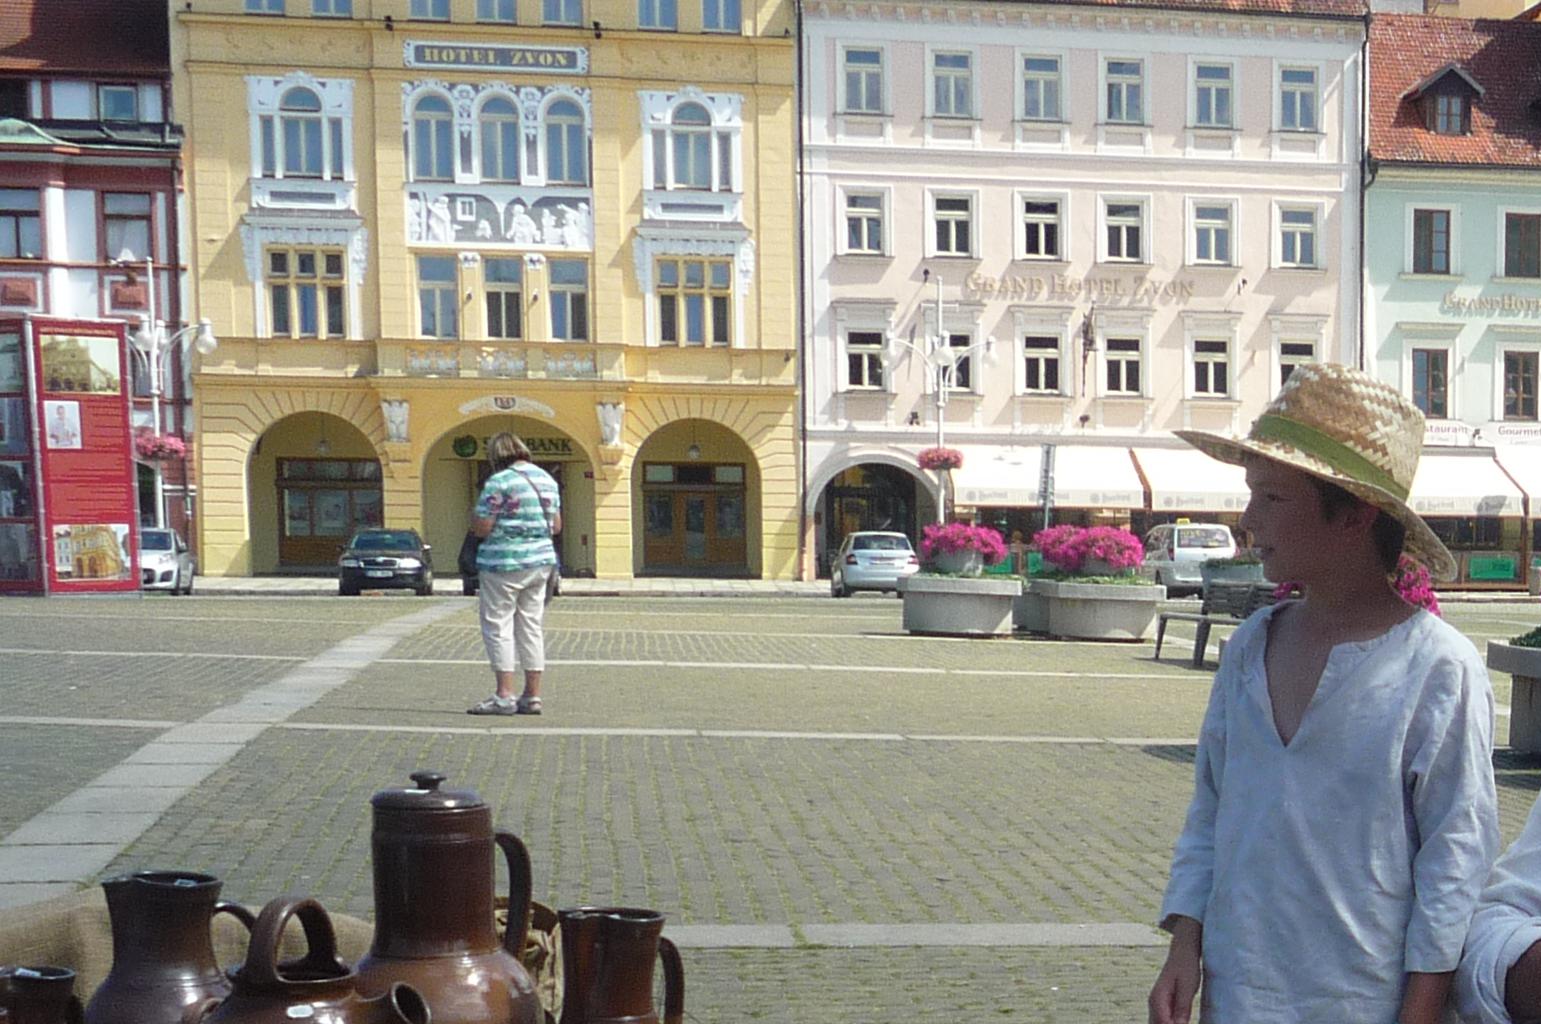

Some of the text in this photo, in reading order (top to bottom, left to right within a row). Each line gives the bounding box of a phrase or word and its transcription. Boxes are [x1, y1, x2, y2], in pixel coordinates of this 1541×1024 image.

[424, 48, 568, 66] HOTEL ZVON
[964, 273, 1194, 298] GRAND HOTEL ZVON
[1423, 424, 1468, 434] staurant
